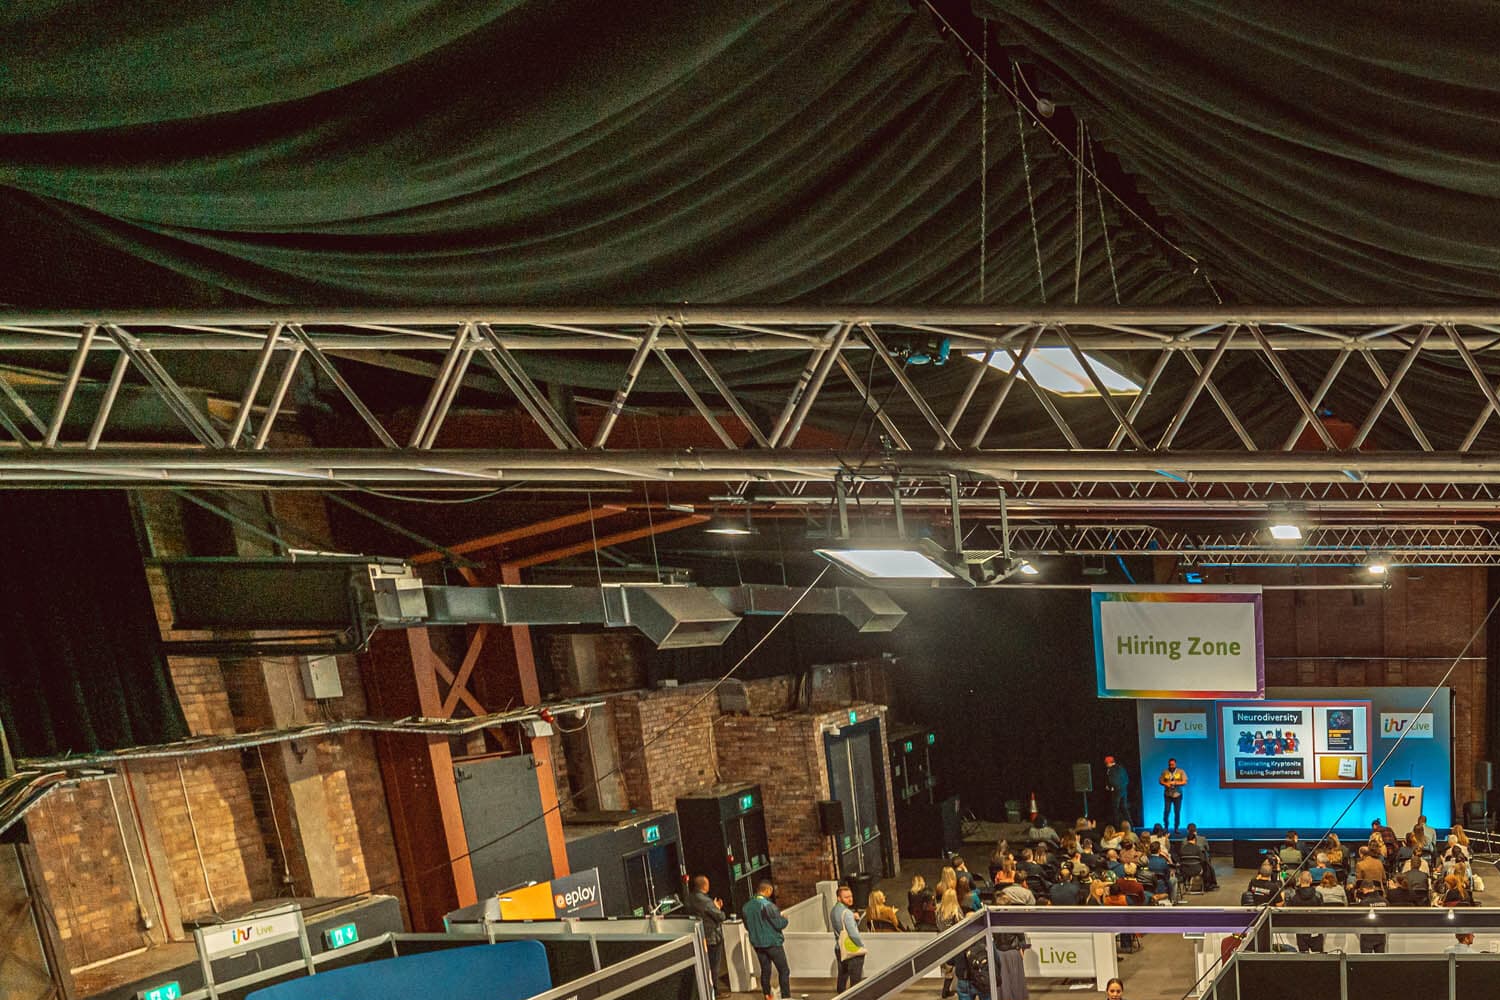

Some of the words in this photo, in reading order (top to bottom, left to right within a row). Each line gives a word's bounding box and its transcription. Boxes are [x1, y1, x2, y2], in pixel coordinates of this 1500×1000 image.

[1117, 635, 1181, 660] Hiring
[1187, 636, 1241, 656] Zone
[1237, 712, 1299, 724] Neurodiversity
[1184, 719, 1204, 731] Live
[1240, 769, 1264, 777] Enabling
[565, 885, 596, 906] eploy
[256, 924, 273, 936] Live
[1039, 947, 1077, 964] Live
